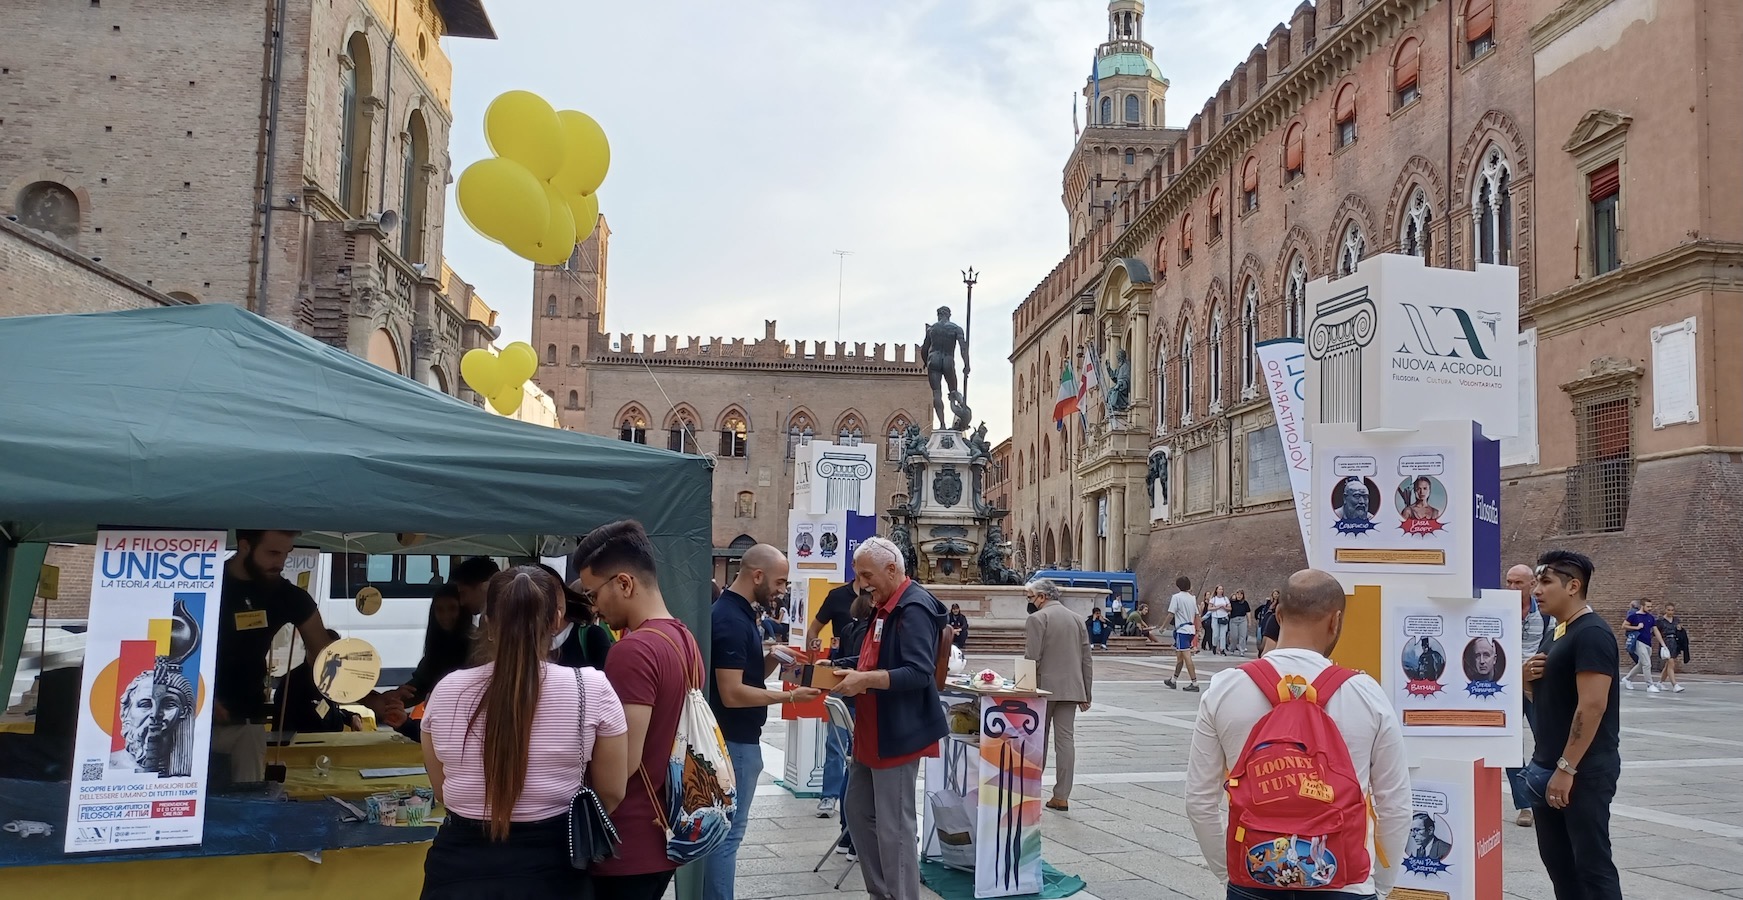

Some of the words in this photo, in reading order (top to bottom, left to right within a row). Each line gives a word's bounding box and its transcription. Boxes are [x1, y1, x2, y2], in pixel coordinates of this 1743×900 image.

[1392, 358, 1436, 372] NUOVA
[1440, 362, 1502, 378] ACROPOLI
[1475, 493, 1498, 524] Filosofia
[104, 538, 126, 550] LA
[132, 538, 218, 552] FILOSOFIA
[102, 552, 217, 580] UNISCE
[116, 580, 150, 588] TEORIA
[1254, 756, 1314, 777] LOONEY
[80, 811, 122, 820] FILOSOFIA
